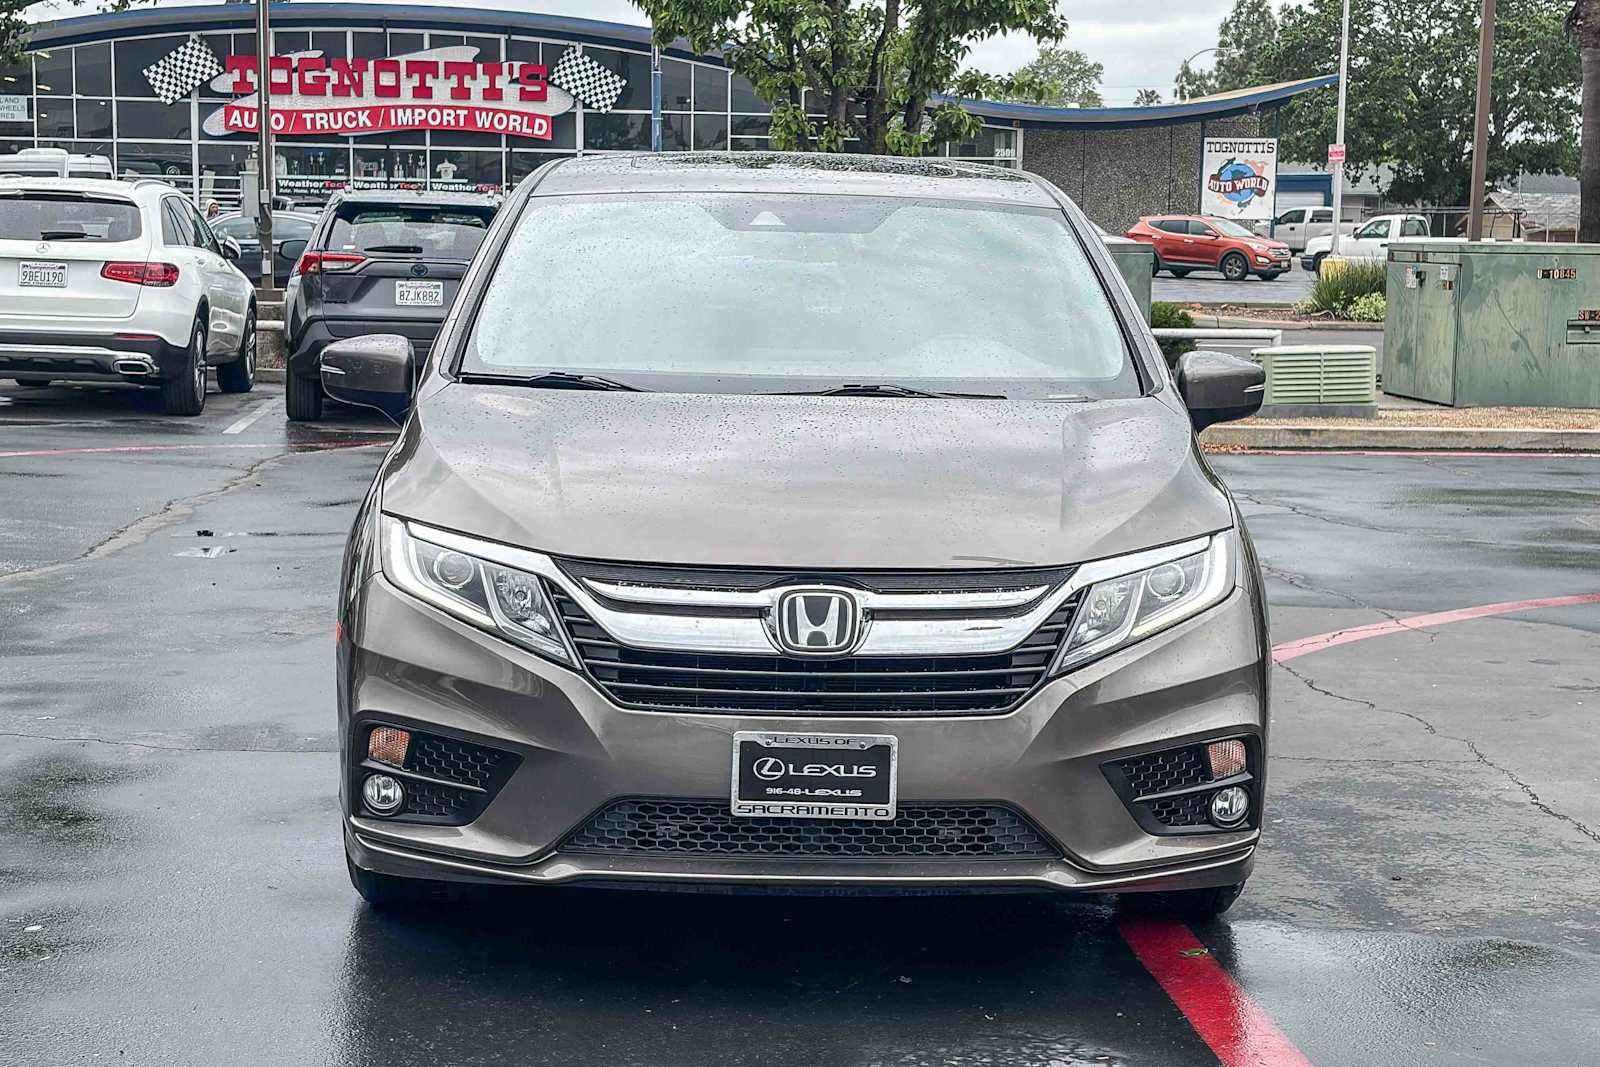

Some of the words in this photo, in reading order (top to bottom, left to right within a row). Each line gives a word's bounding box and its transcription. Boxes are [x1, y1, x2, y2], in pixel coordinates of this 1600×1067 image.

[225, 55, 548, 101] TOGNOTTI'S
[229, 109, 285, 130] AUO
[302, 108, 372, 128] TRUCK
[390, 107, 467, 127] IMPORT
[474, 112, 548, 136] WORLD
[1209, 180, 1232, 192] AUTO
[1234, 178, 1269, 191] WORLD
[22, 270, 64, 283] 9BEU190
[774, 736, 831, 745] LEXUS
[789, 763, 877, 777] LEXUS
[766, 787, 862, 797] 916-48-LEXUS
[737, 804, 890, 817] SACRAMENTO
